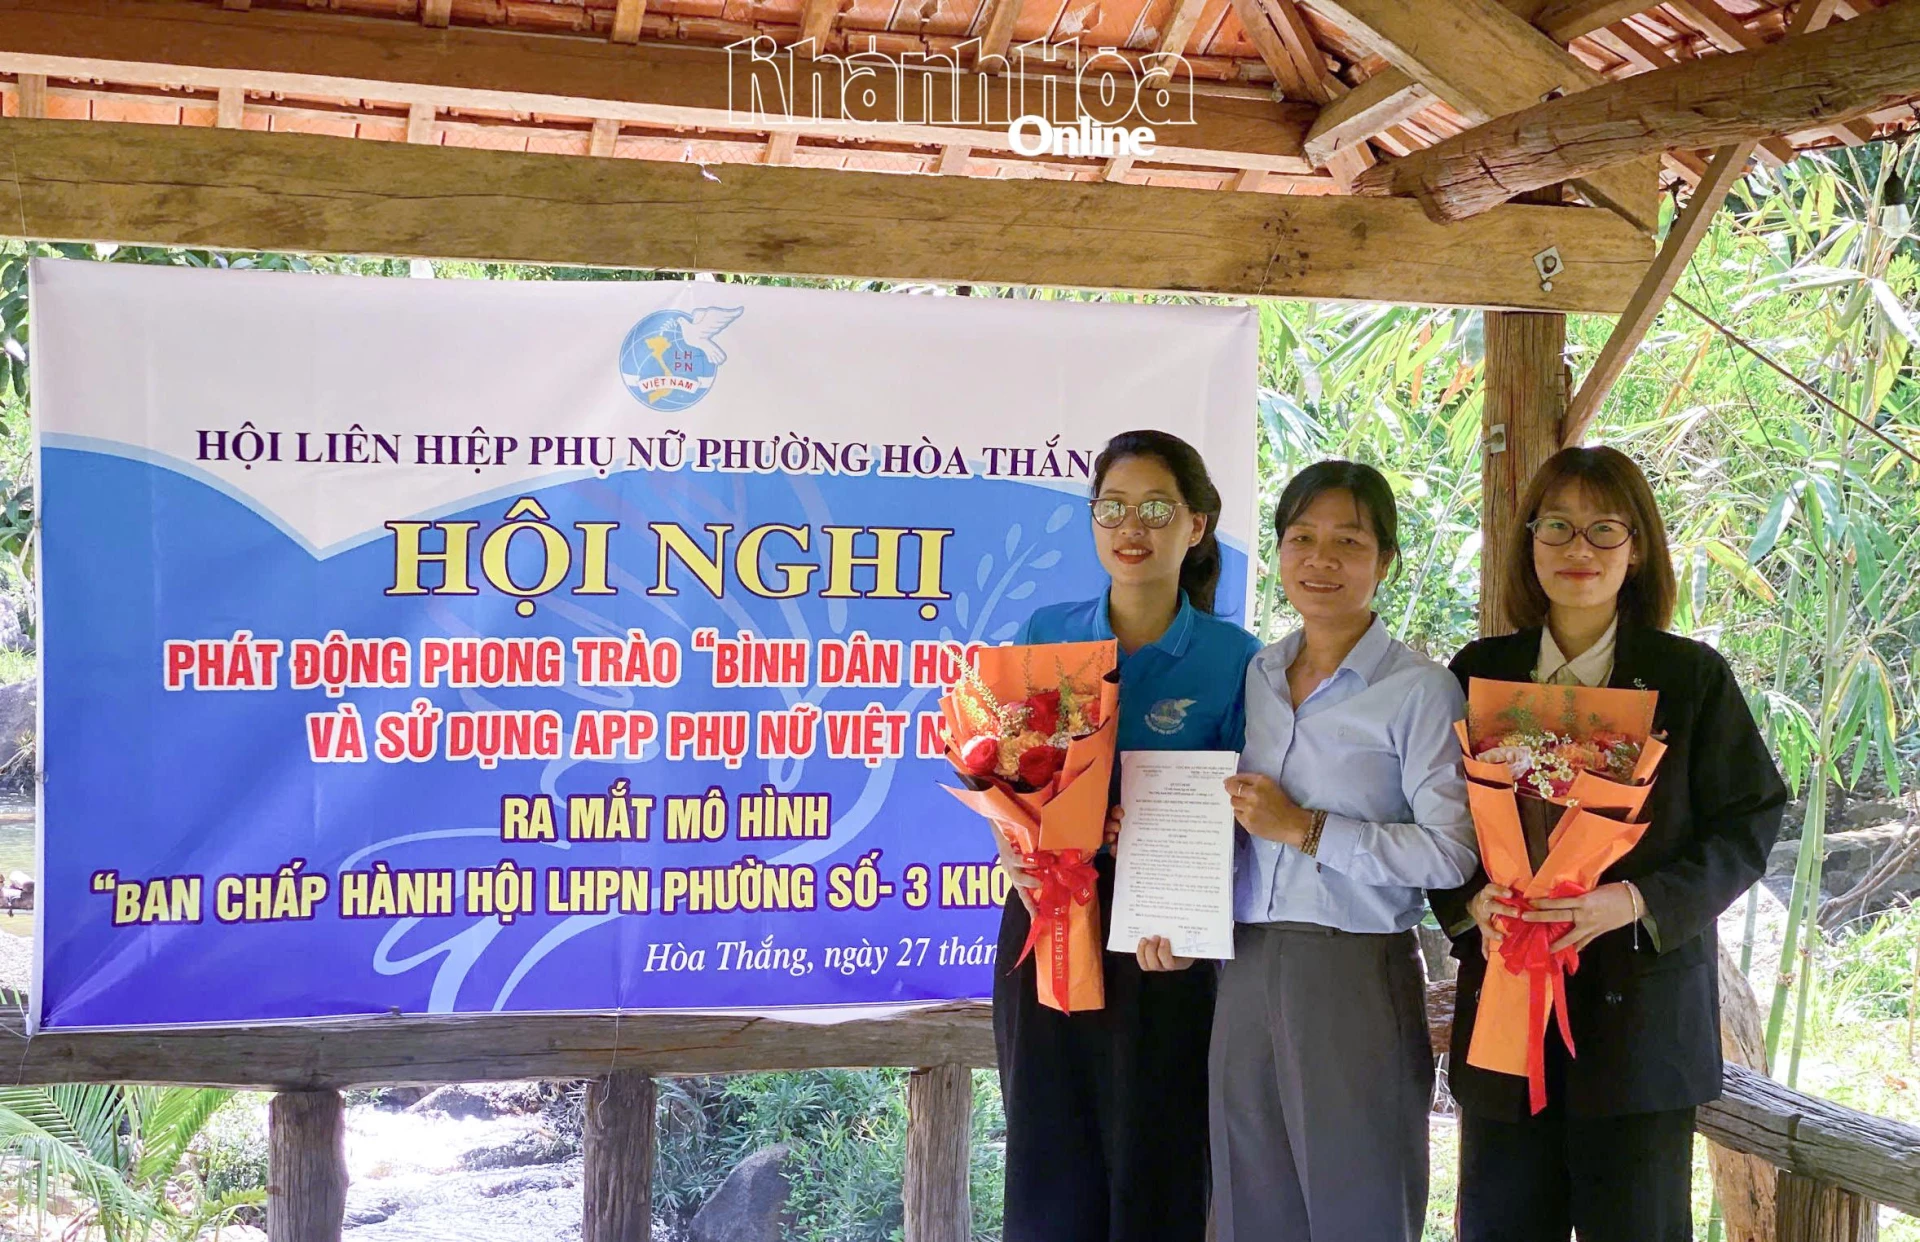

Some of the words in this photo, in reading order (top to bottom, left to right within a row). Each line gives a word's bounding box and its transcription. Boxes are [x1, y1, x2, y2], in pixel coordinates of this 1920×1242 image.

[669, 378, 694, 390] NAM
[197, 421, 280, 470] HỘI
[296, 423, 398, 464] LIÊN
[415, 426, 518, 474] HIỆP
[529, 436, 614, 475] PHỤ
[628, 429, 686, 467] NỮ
[698, 431, 868, 472] PHƯỜNG
[883, 435, 969, 475] HÒA
[982, 433, 1099, 479] THẮN
[384, 496, 619, 617] HỘI
[646, 523, 955, 621] NGHỊ
[169, 633, 278, 685] PHÁT
[293, 634, 406, 692] ĐỘNG
[424, 641, 561, 684] PHONG
[576, 632, 677, 684] TRÀO
[695, 631, 806, 684] “BÌNH
[821, 634, 899, 684] DÂN
[311, 706, 362, 758] VÀ
[379, 702, 439, 759] SỬ
[450, 714, 558, 764] DỤNG
[574, 715, 654, 755] APP
[670, 715, 746, 765] PHỤ
[760, 706, 818, 755] NỮ
[828, 706, 906, 764] VIỆT
[504, 798, 554, 839] RA
[570, 783, 652, 838] MẮT
[667, 790, 725, 839] MÔ
[740, 788, 828, 837] HÌNH
[94, 874, 199, 922] “BAN
[217, 861, 325, 920] CHẤP
[343, 864, 451, 915] HÀNH
[468, 863, 532, 921] HỘI
[549, 871, 647, 911] LHPN
[664, 858, 813, 911] PHƯỜNG
[907, 867, 927, 906] 3
[643, 942, 705, 972] Hòa
[716, 934, 813, 976] Thắng,
[824, 938, 888, 975] ngày
[896, 937, 931, 966] 27
[939, 936, 998, 966] thán
